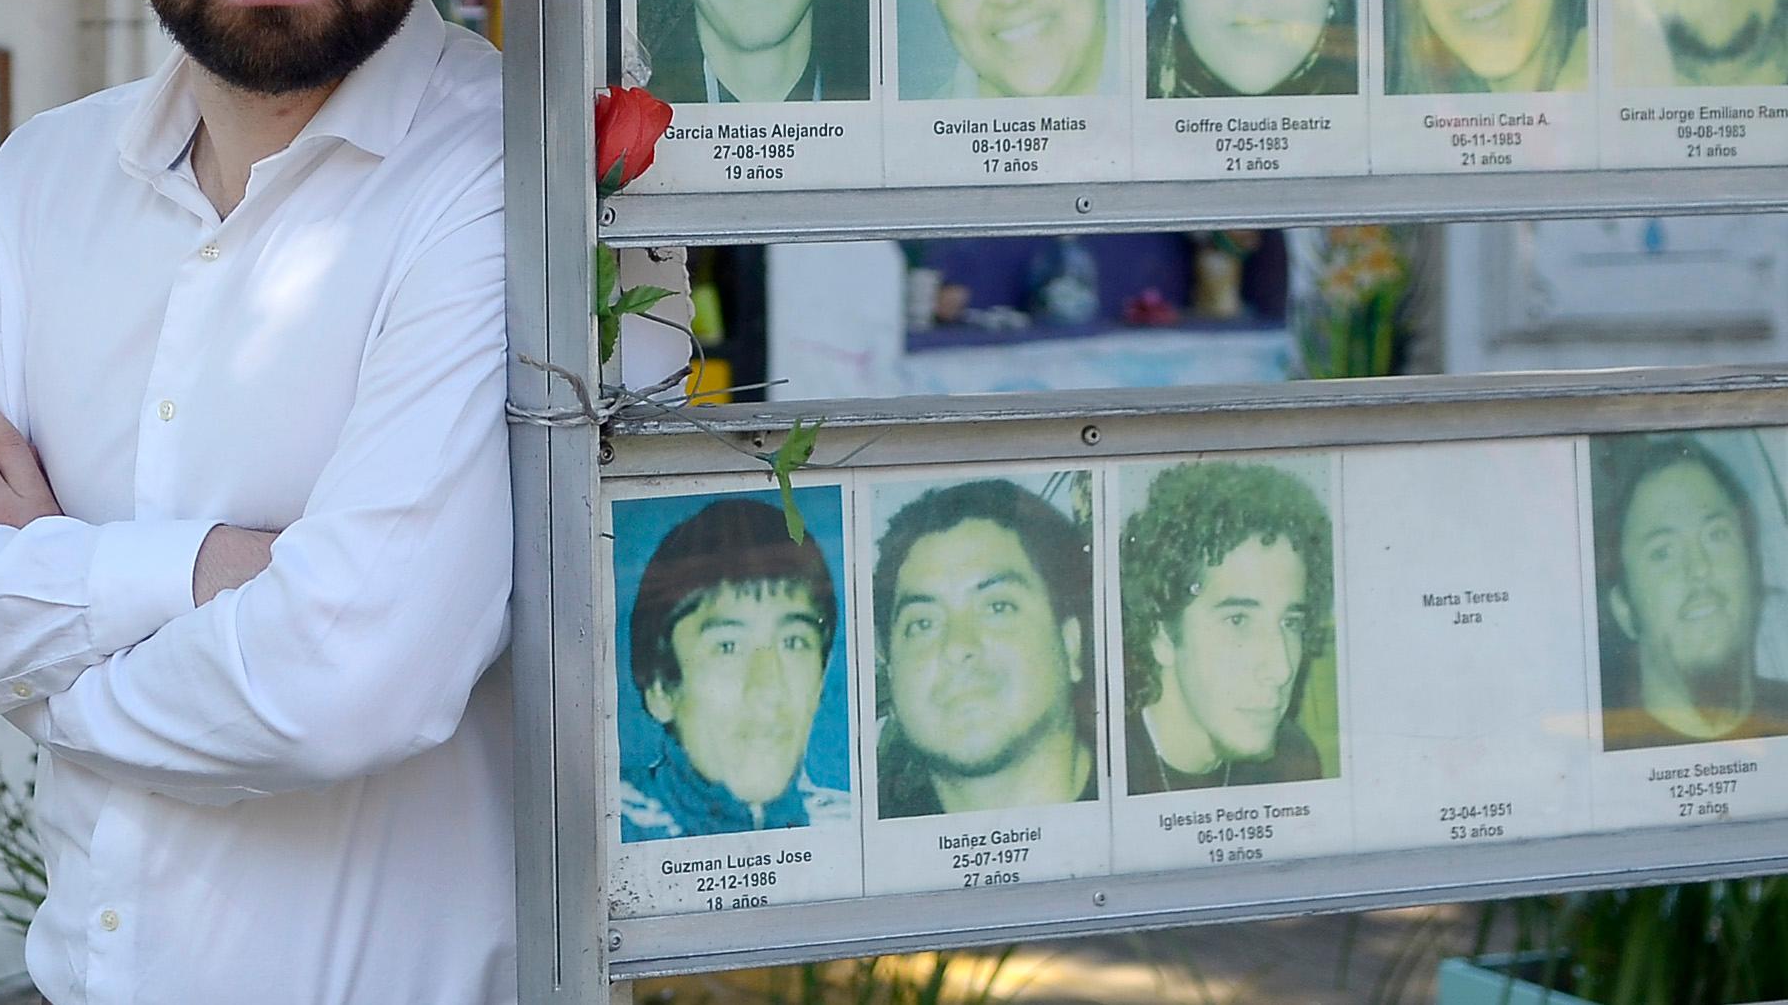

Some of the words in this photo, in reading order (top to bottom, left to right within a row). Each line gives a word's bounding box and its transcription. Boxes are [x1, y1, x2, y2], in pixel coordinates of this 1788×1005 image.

[1424, 113, 1495, 129] Giovannini
[1499, 113, 1534, 127] Carla
[1620, 107, 1655, 121] Giralt
[1659, 107, 1695, 123] Jorge
[1699, 106, 1754, 120] Emiliano
[664, 125, 713, 140] Garcia
[718, 124, 767, 139] Matias
[771, 123, 844, 141] Alejandro
[933, 119, 989, 135] Gavilan
[993, 119, 1036, 133] Lucas
[1041, 117, 1086, 132] Matias
[1175, 119, 1223, 133] Gioffre
[1227, 117, 1278, 132] Claudia
[1282, 116, 1331, 131] Beatriz
[713, 144, 795, 160] 27-08-1985
[972, 137, 1049, 153] 08-10-1987
[1216, 137, 1289, 152] 07-05-1983
[1687, 144, 1701, 158] 21
[1707, 144, 1737, 157] años
[983, 158, 1000, 173] 17
[1004, 159, 1038, 173] años
[1226, 157, 1241, 171] 21
[1246, 156, 1280, 171] años
[1461, 152, 1476, 166] 21
[1481, 151, 1512, 166] años
[725, 165, 742, 179] 19
[746, 165, 783, 180] años
[1422, 593, 1461, 607] Marta
[1464, 590, 1509, 604] Teresa
[1453, 611, 1482, 625] Jara
[1648, 767, 1690, 782] Juarez
[1694, 760, 1758, 778] Sebastian
[1670, 779, 1738, 798] 12-05-1977
[1159, 811, 1212, 831] Iglesias
[1216, 807, 1259, 823] Pedro
[1263, 803, 1311, 820] Tomas
[1440, 802, 1512, 822] 23-04-1951
[1679, 803, 1694, 817] 27
[1698, 801, 1729, 815] años
[939, 833, 987, 850] Ibañez
[990, 827, 1042, 845] Gabriel
[1451, 825, 1467, 840] 53
[1470, 823, 1504, 838] años
[661, 857, 722, 875] Guzman
[727, 852, 772, 870] Lucas
[776, 849, 812, 865] Jose
[952, 847, 1029, 869] 25-07-1977
[1208, 849, 1224, 863] 19
[1228, 846, 1263, 862] años
[697, 871, 777, 892] 22-12-1986
[963, 872, 980, 888] 27
[985, 870, 1020, 886] años
[706, 896, 723, 911] 18
[732, 894, 768, 910] años
